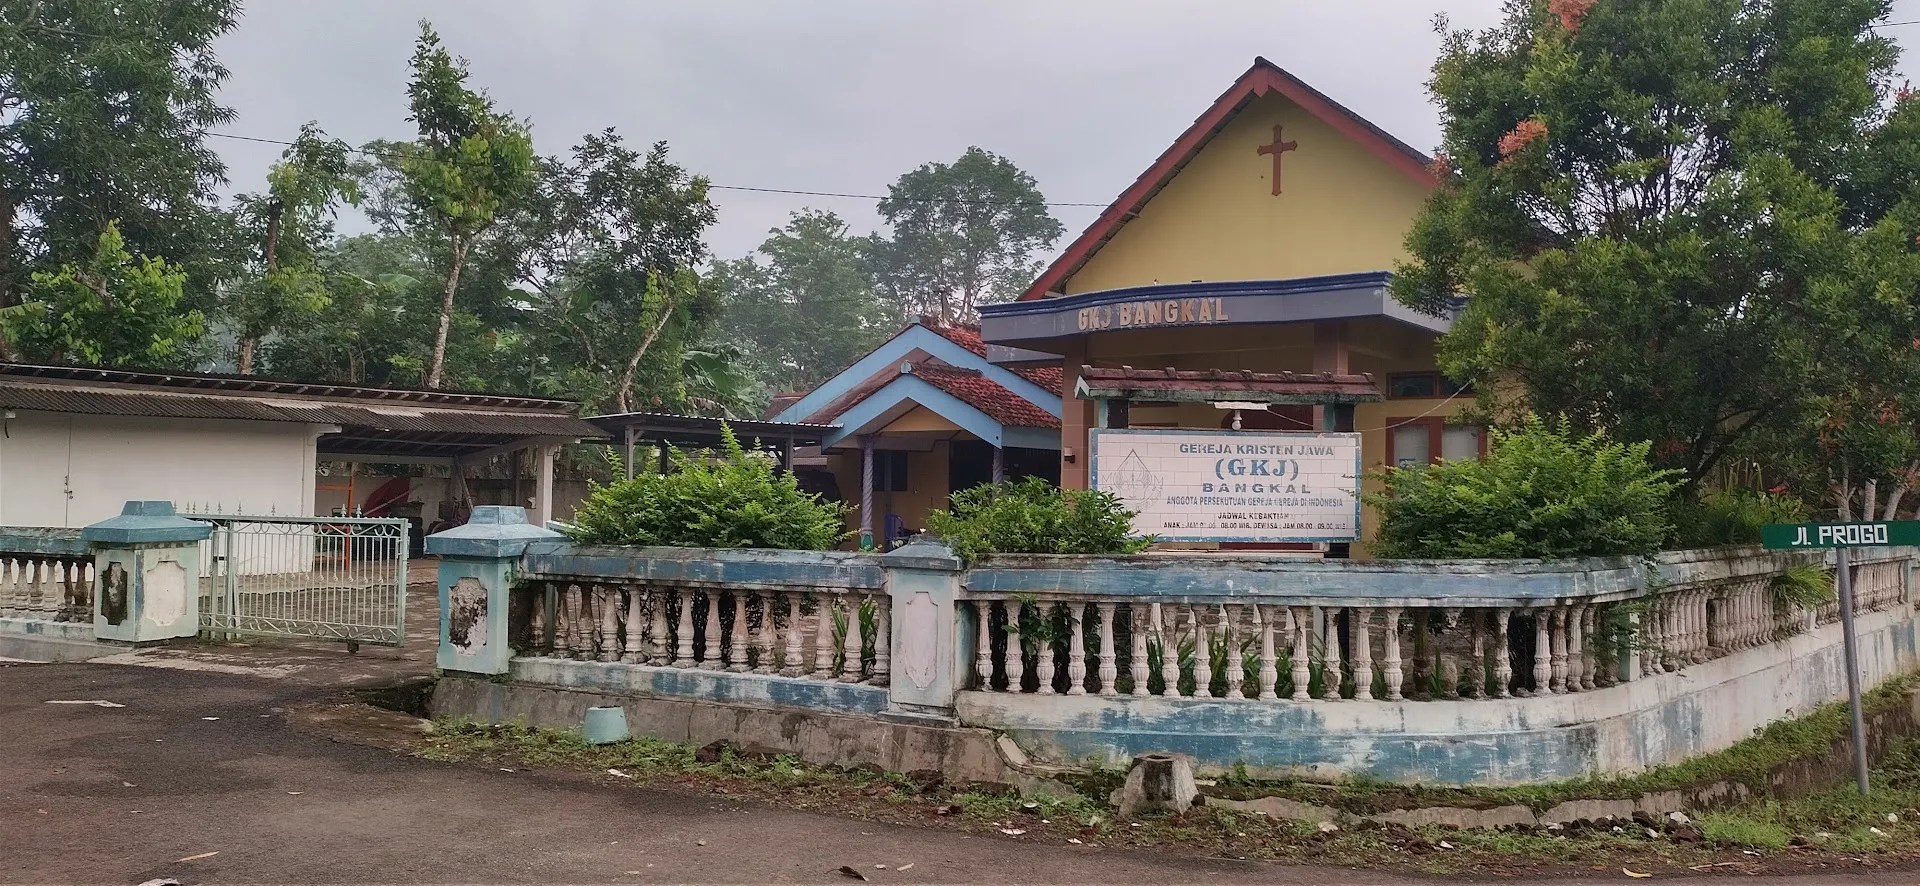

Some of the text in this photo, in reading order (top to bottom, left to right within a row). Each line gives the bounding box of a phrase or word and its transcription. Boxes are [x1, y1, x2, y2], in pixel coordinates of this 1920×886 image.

[1078, 296, 1229, 330] GKJ BANGKAL
[1180, 443, 1334, 456] GEREJA KRISTEN JAWA
[1215, 458, 1299, 481] (GKJ)
[1202, 483, 1311, 494] BANGKAL
[1167, 496, 1197, 505] ANGGOTA
[1200, 496, 1246, 506] PERSEKUTUAN
[1248, 497, 1272, 506] GEREJA
[1308, 498, 1343, 507] INDONESIA
[1217, 512, 1247, 520] JADWAL
[1163, 521, 1180, 529] ANAK
[1818, 524, 1889, 545] PROGO
